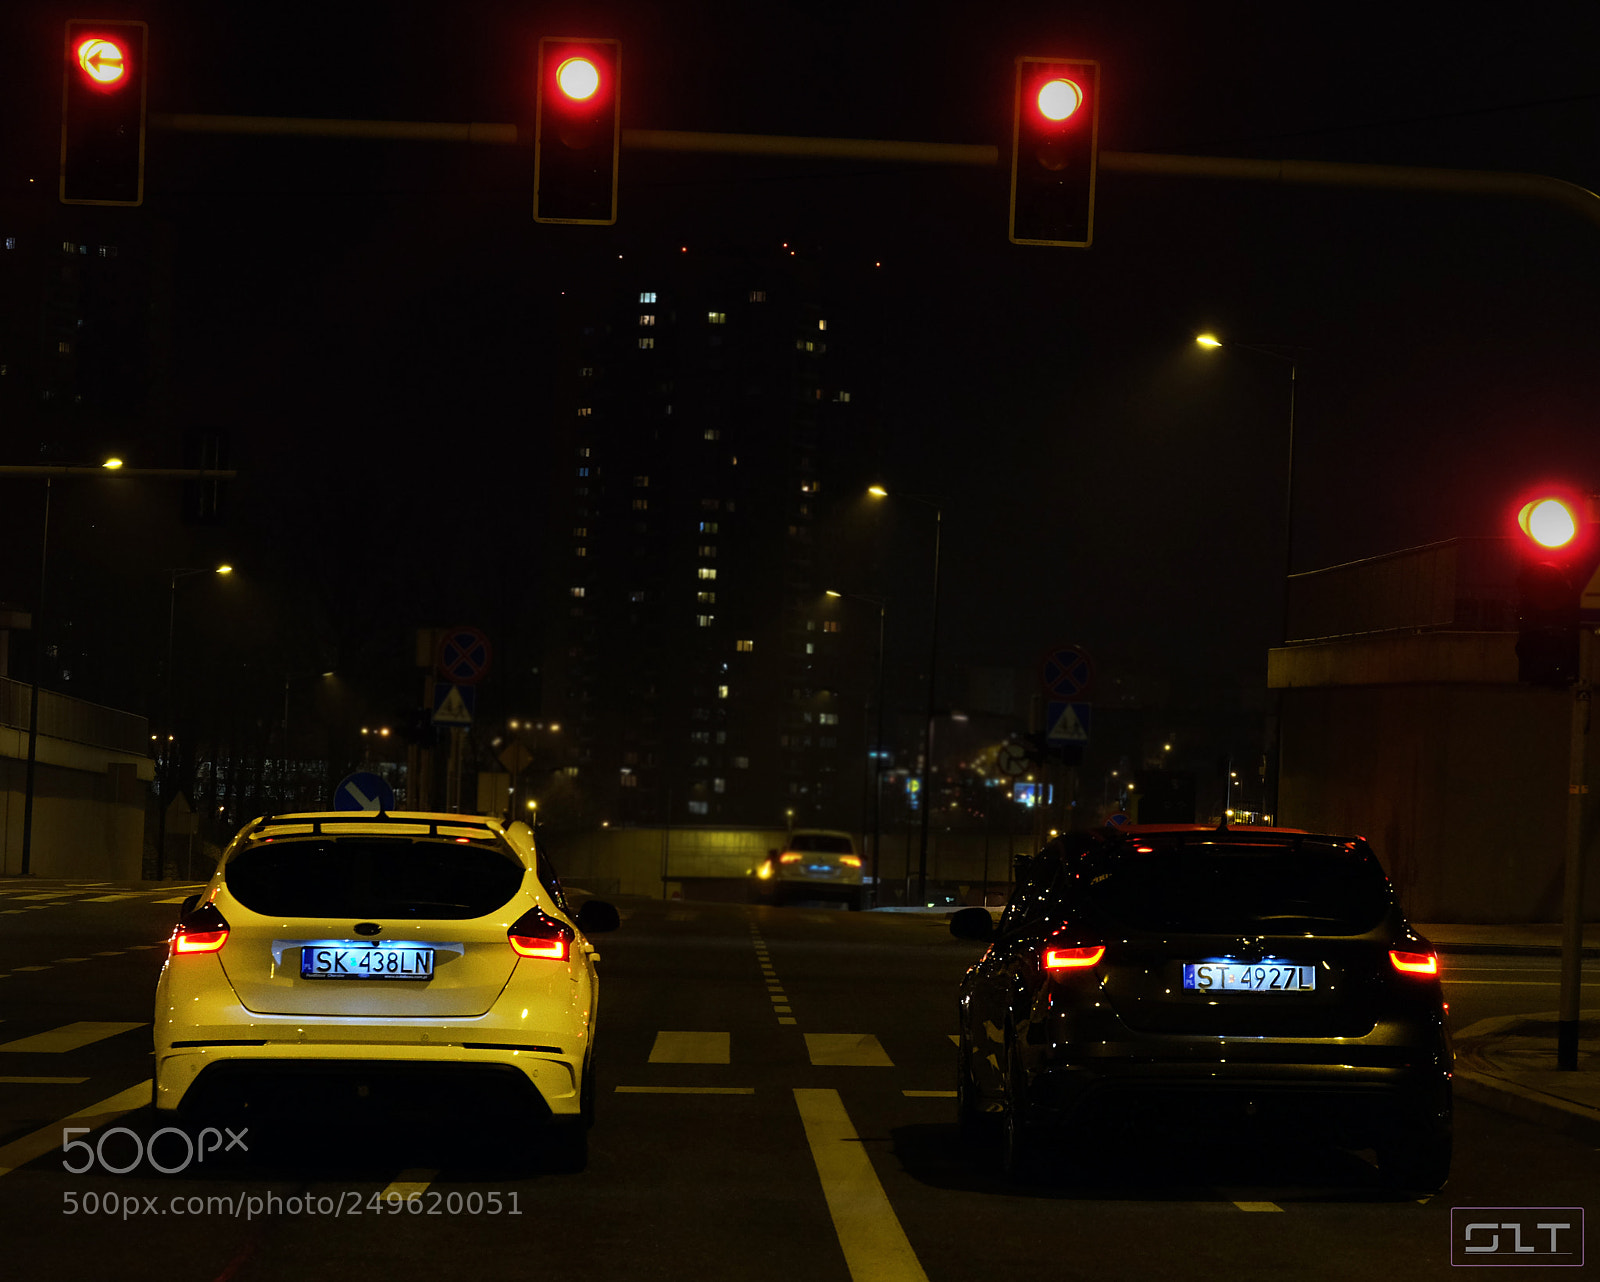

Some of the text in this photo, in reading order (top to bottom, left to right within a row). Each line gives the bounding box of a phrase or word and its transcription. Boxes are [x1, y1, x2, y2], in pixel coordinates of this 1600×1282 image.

[316, 951, 430, 974] SK 438LN
[1197, 966, 1311, 990] ST 4927L
